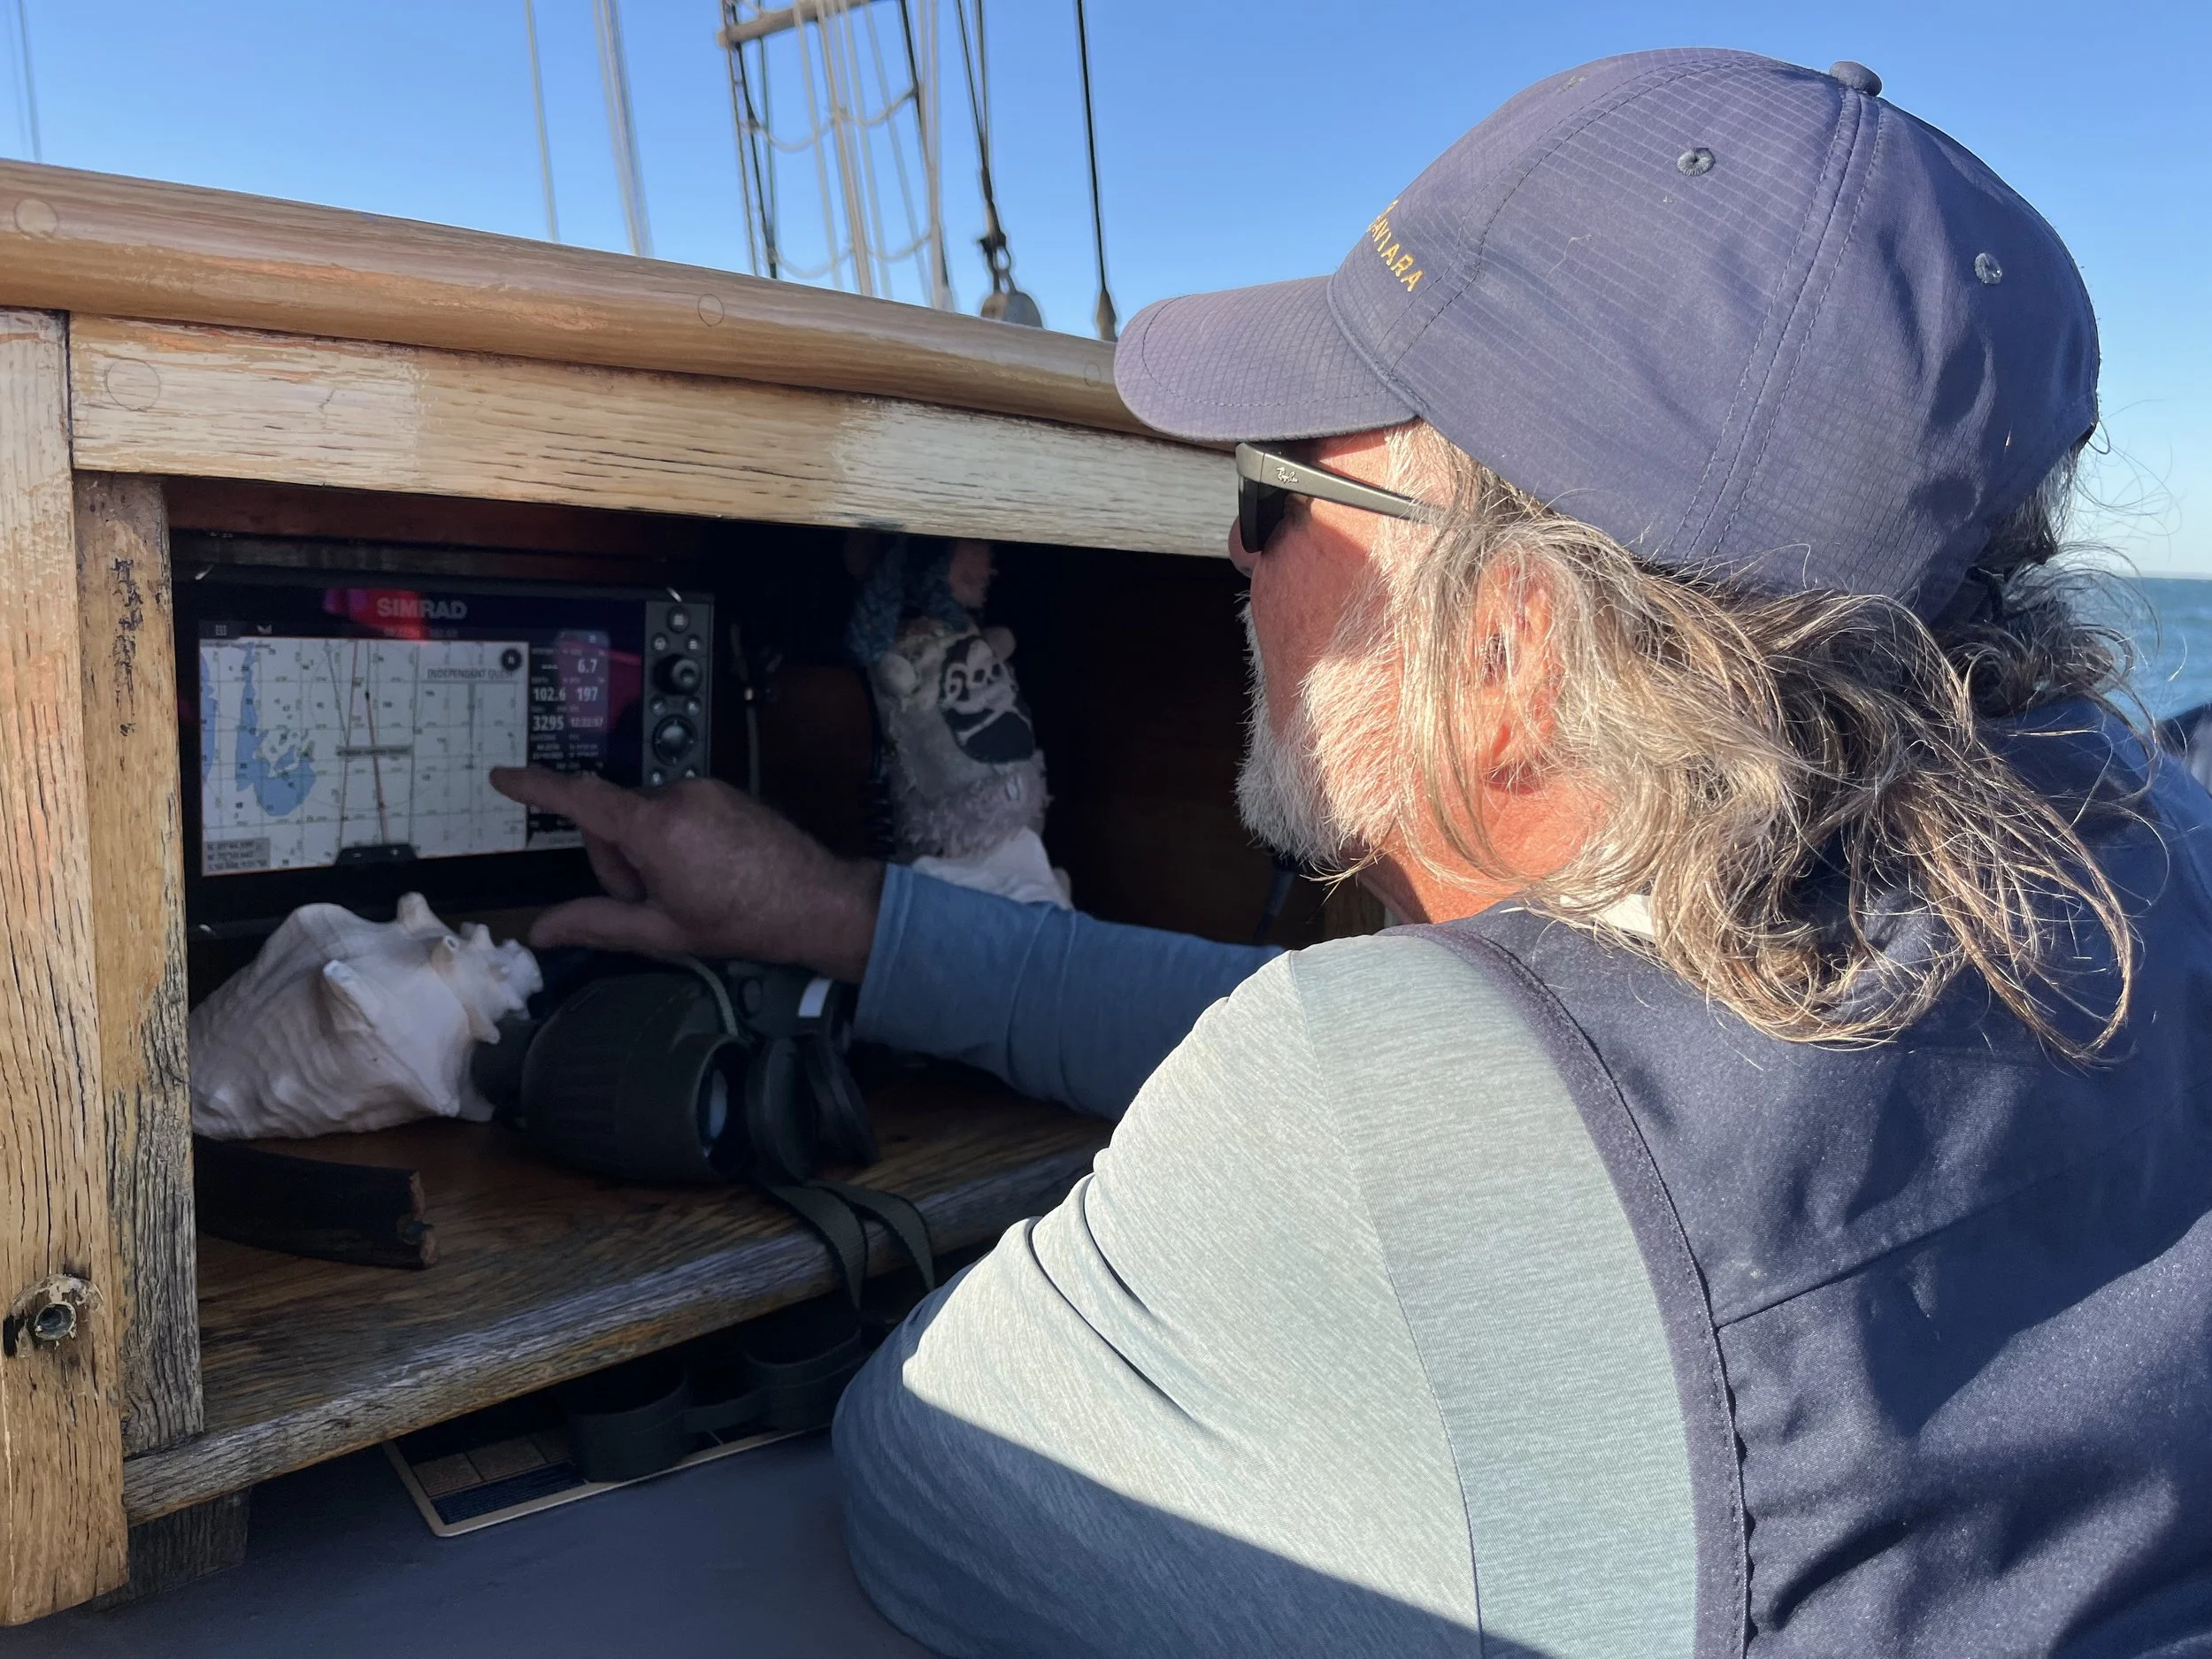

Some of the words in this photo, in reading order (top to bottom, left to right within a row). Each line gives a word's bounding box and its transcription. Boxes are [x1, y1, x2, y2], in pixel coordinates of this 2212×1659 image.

[376, 597, 469, 620] SIMRAD
[578, 657, 598, 673] 6.7
[533, 686, 566, 702] 102.6
[576, 686, 599, 702] 197
[532, 714, 565, 732] 3295
